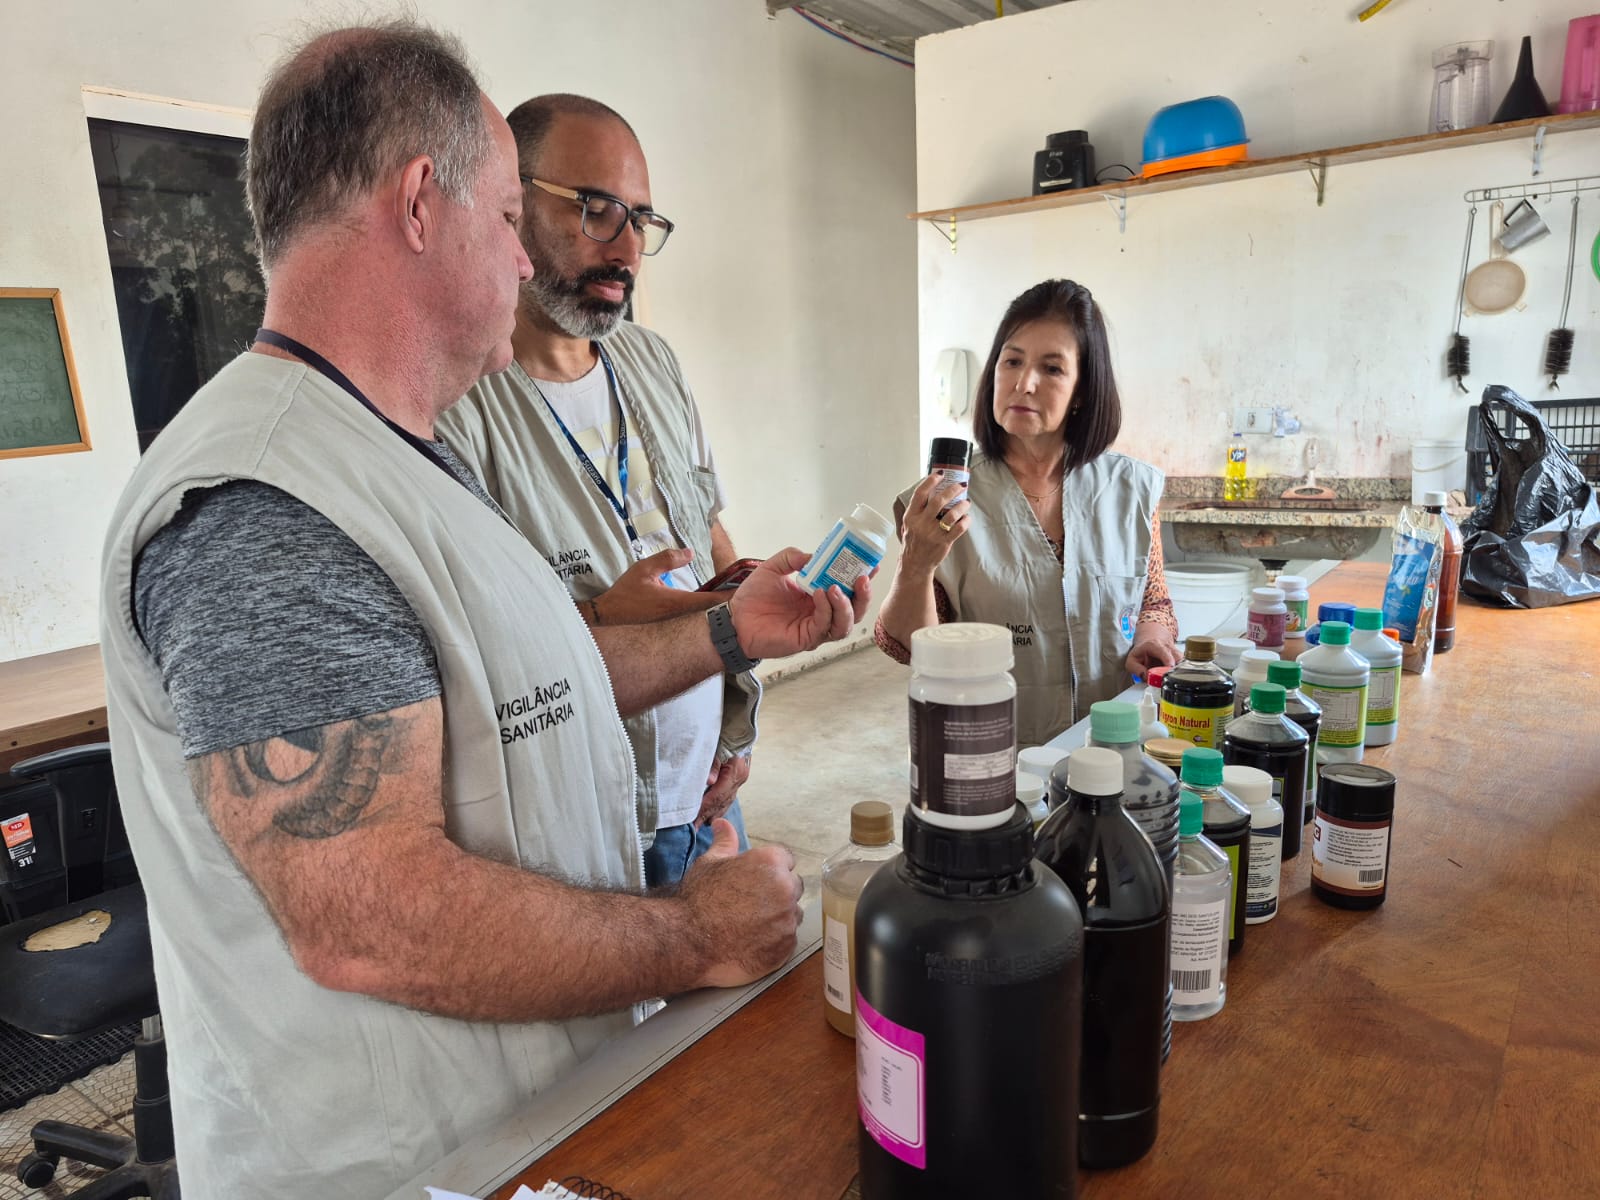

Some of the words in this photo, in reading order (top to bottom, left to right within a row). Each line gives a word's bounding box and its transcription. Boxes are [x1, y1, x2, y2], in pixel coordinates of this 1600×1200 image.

[495, 677, 572, 722] VIGILÂNCIA
[500, 702, 575, 744] SANITÁRIA
[1179, 715, 1210, 729] Natural
